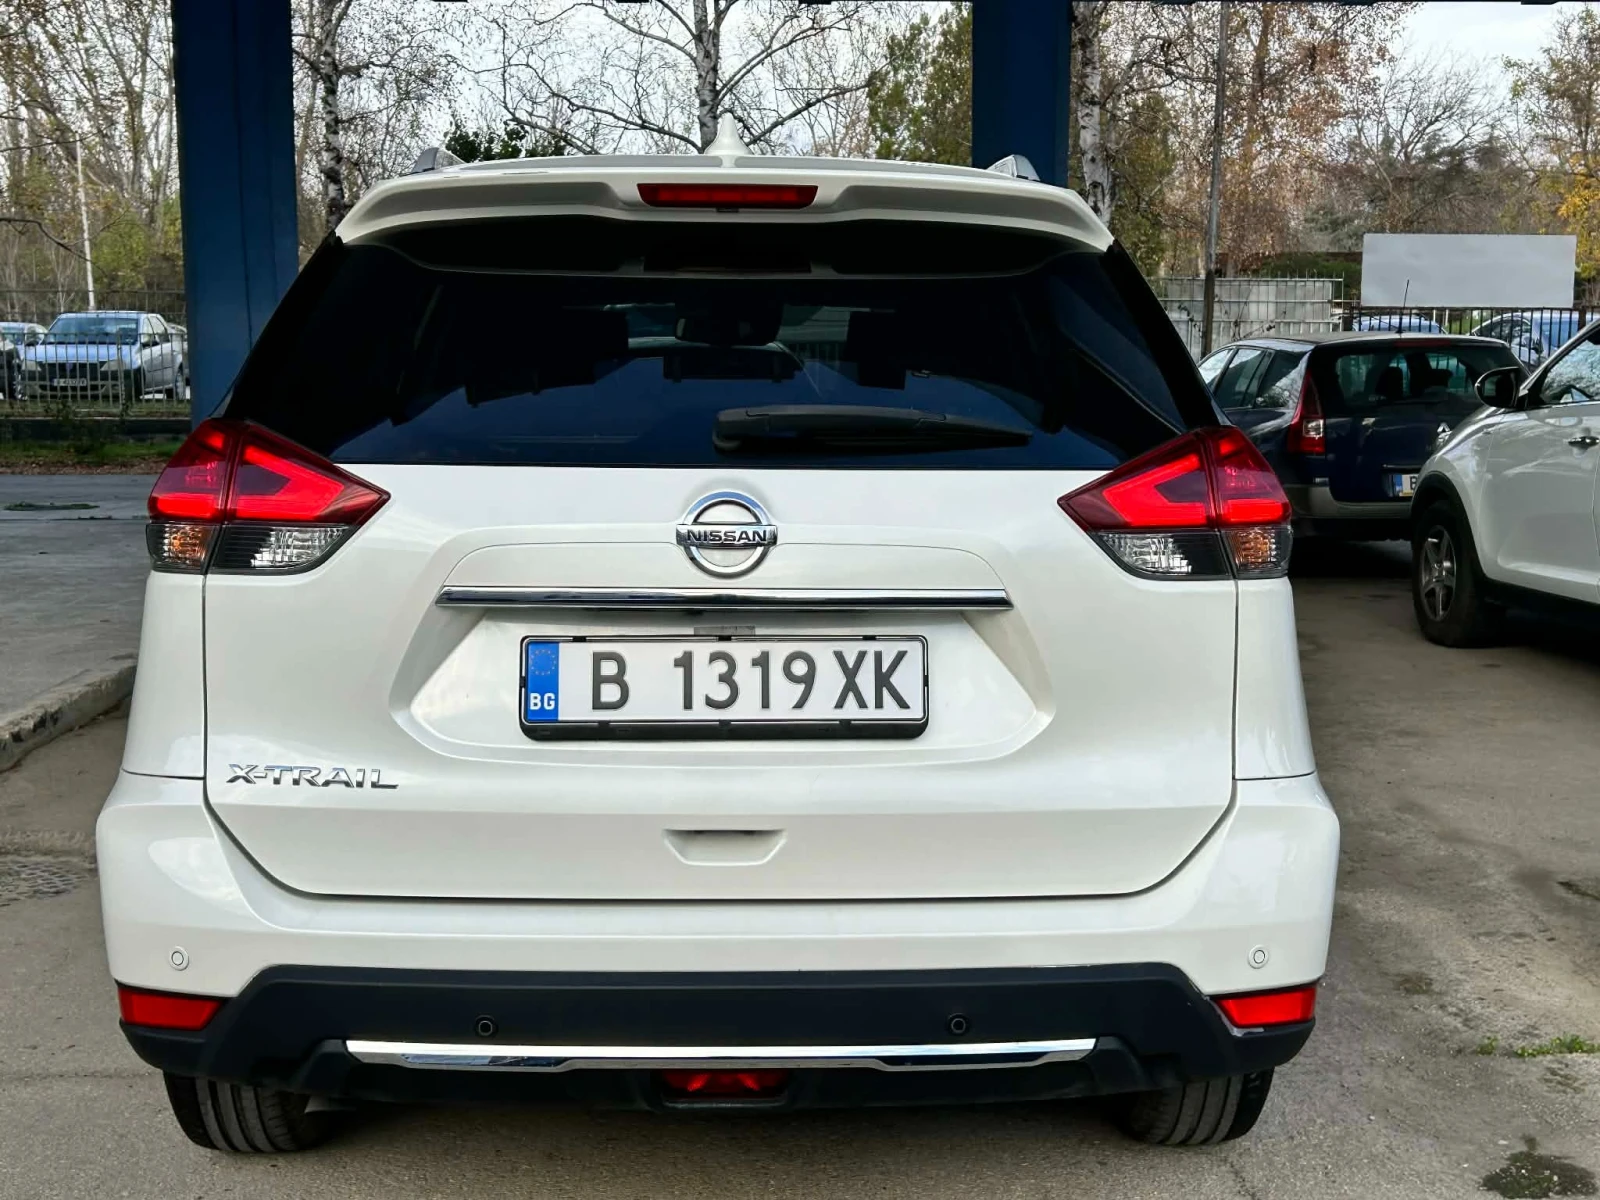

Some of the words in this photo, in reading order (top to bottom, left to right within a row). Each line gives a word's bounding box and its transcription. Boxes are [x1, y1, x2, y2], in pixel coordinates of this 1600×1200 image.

[686, 529, 767, 543] NISSAN
[592, 651, 630, 710] B
[673, 650, 817, 710] 1319
[833, 650, 911, 710] XK
[529, 692, 556, 710] BG
[225, 763, 399, 789] X-TRAIL
